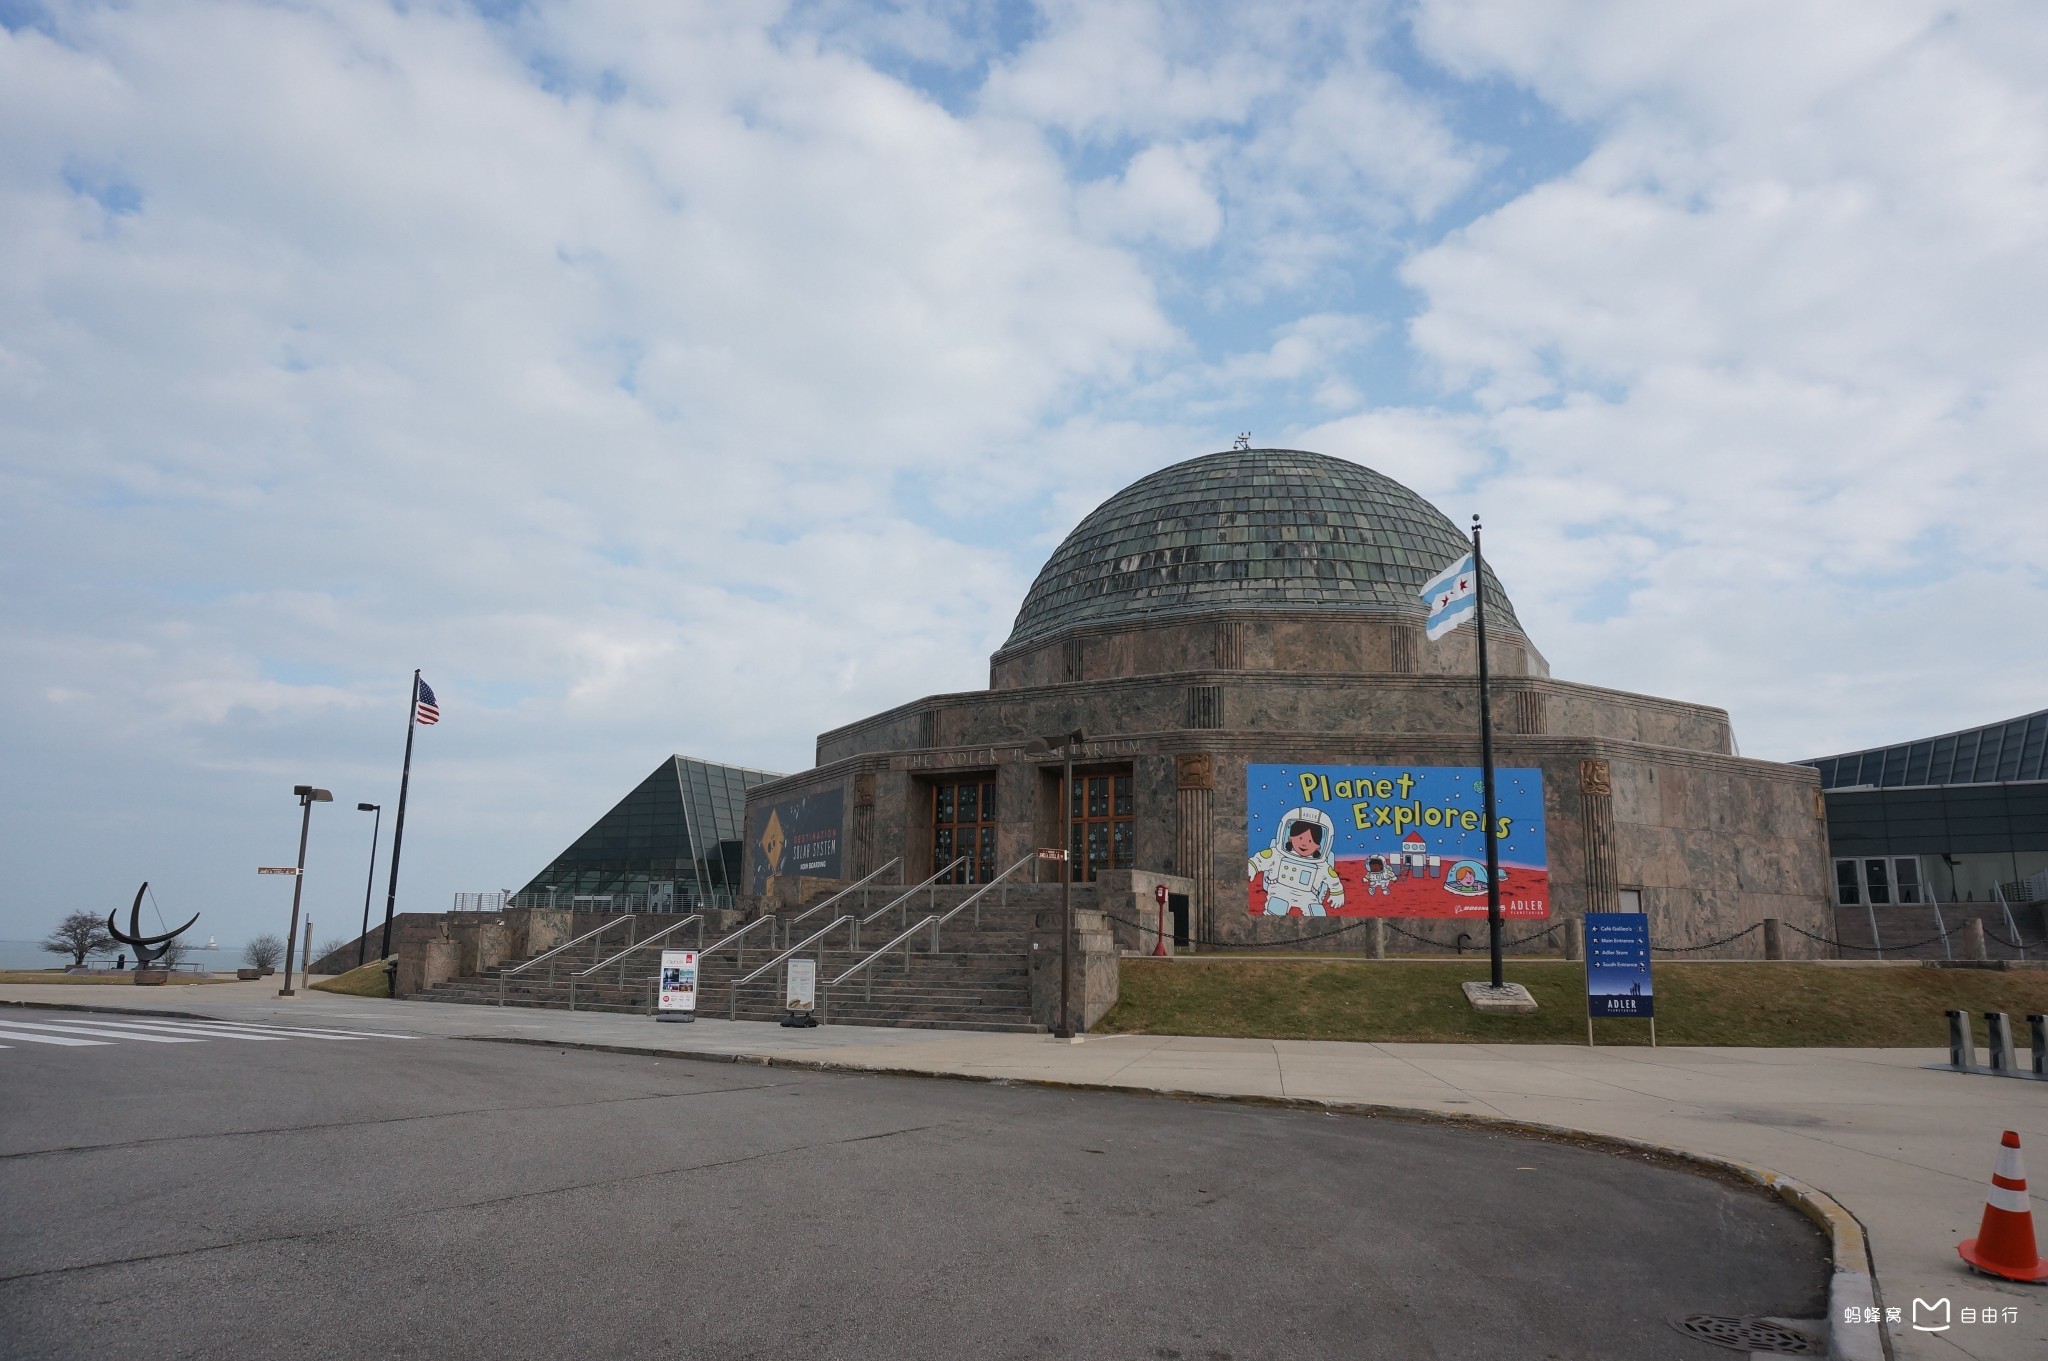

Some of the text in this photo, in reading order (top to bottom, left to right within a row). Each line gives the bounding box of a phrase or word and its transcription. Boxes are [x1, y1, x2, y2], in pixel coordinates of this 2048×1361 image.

[901, 740, 1141, 767] THE ADLER PLETARIUM
[1299, 772, 1415, 803] Planet
[794, 829, 836, 844] DESTINATION
[794, 840, 836, 859] SOLAR SYSTEM
[1510, 900, 1543, 911] ADLER
[1607, 1000, 1637, 1009] ADLER
